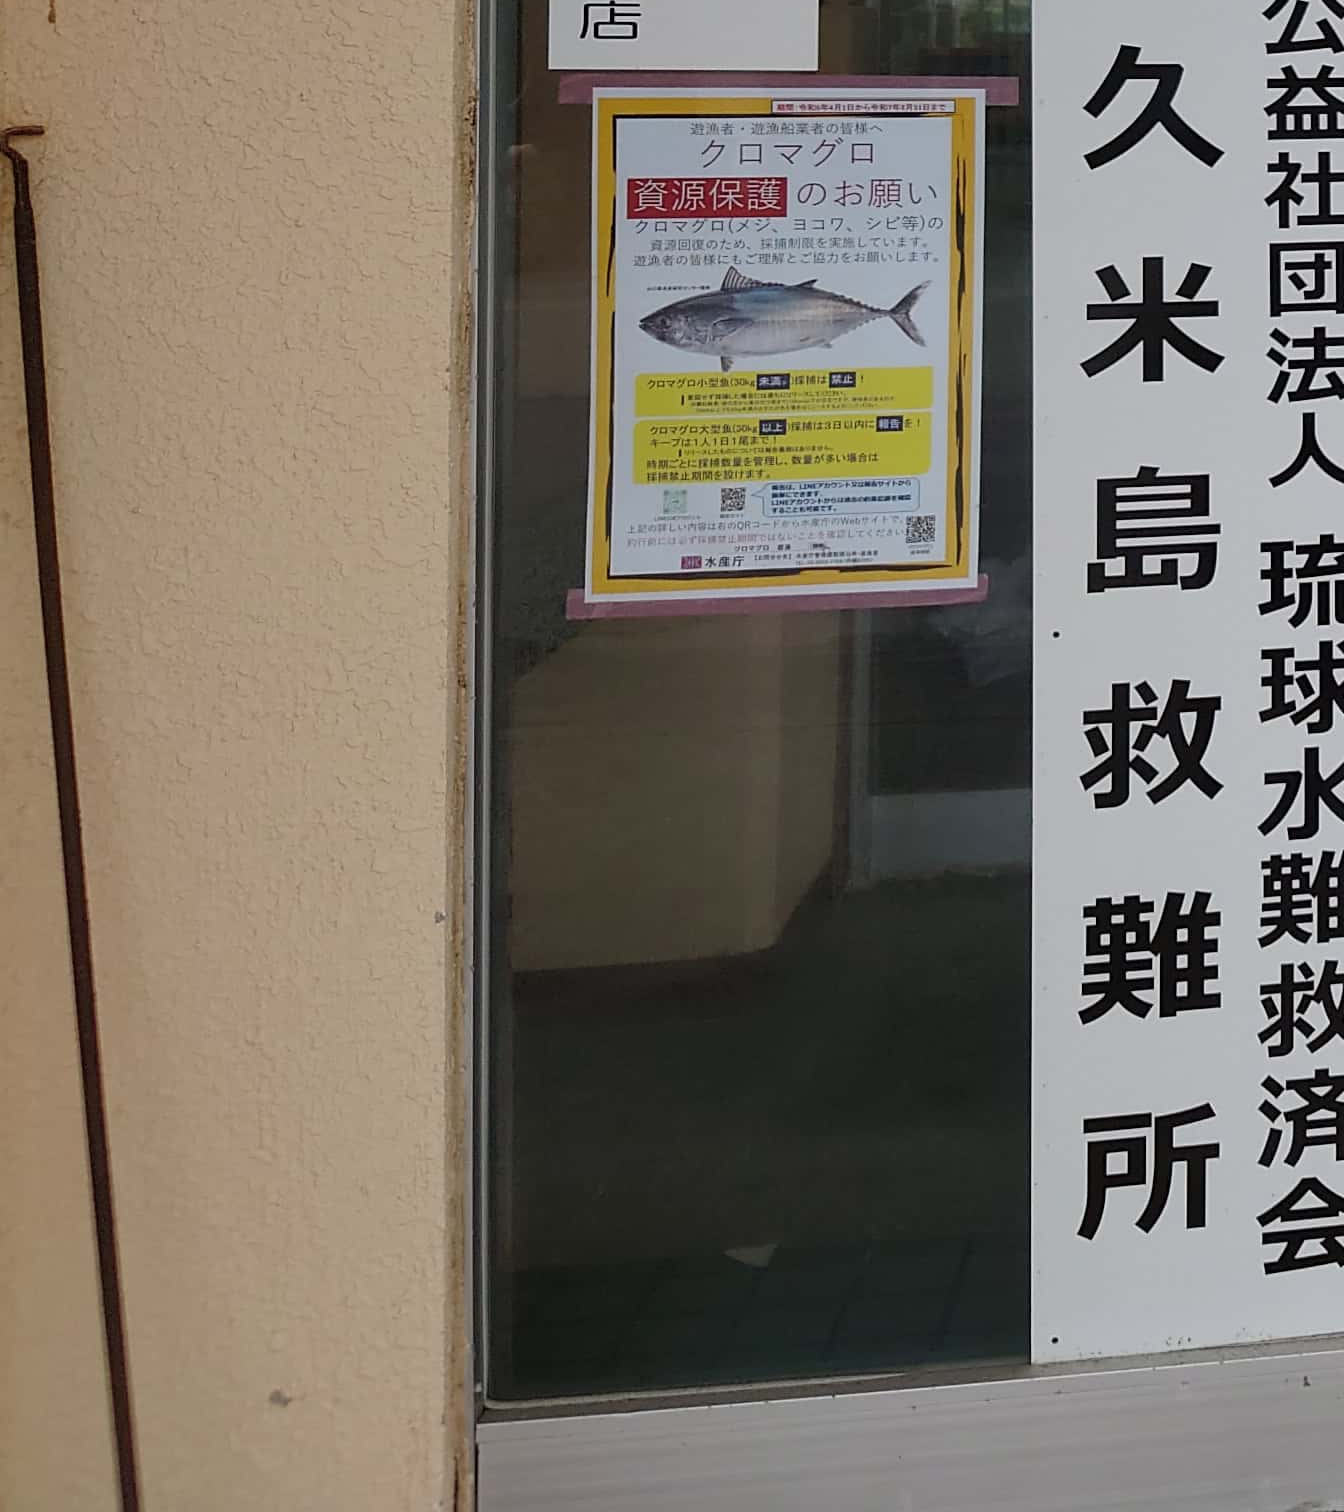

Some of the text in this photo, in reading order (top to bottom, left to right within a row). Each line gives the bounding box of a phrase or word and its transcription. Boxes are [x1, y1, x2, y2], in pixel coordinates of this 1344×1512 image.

[701, 138, 875, 168] クロマグロ
[633, 178, 937, 212] 資源保護 のお願い
[705, 555, 745, 569] 水産庁
[1077, 41, 1225, 1242] 久米島救難所
